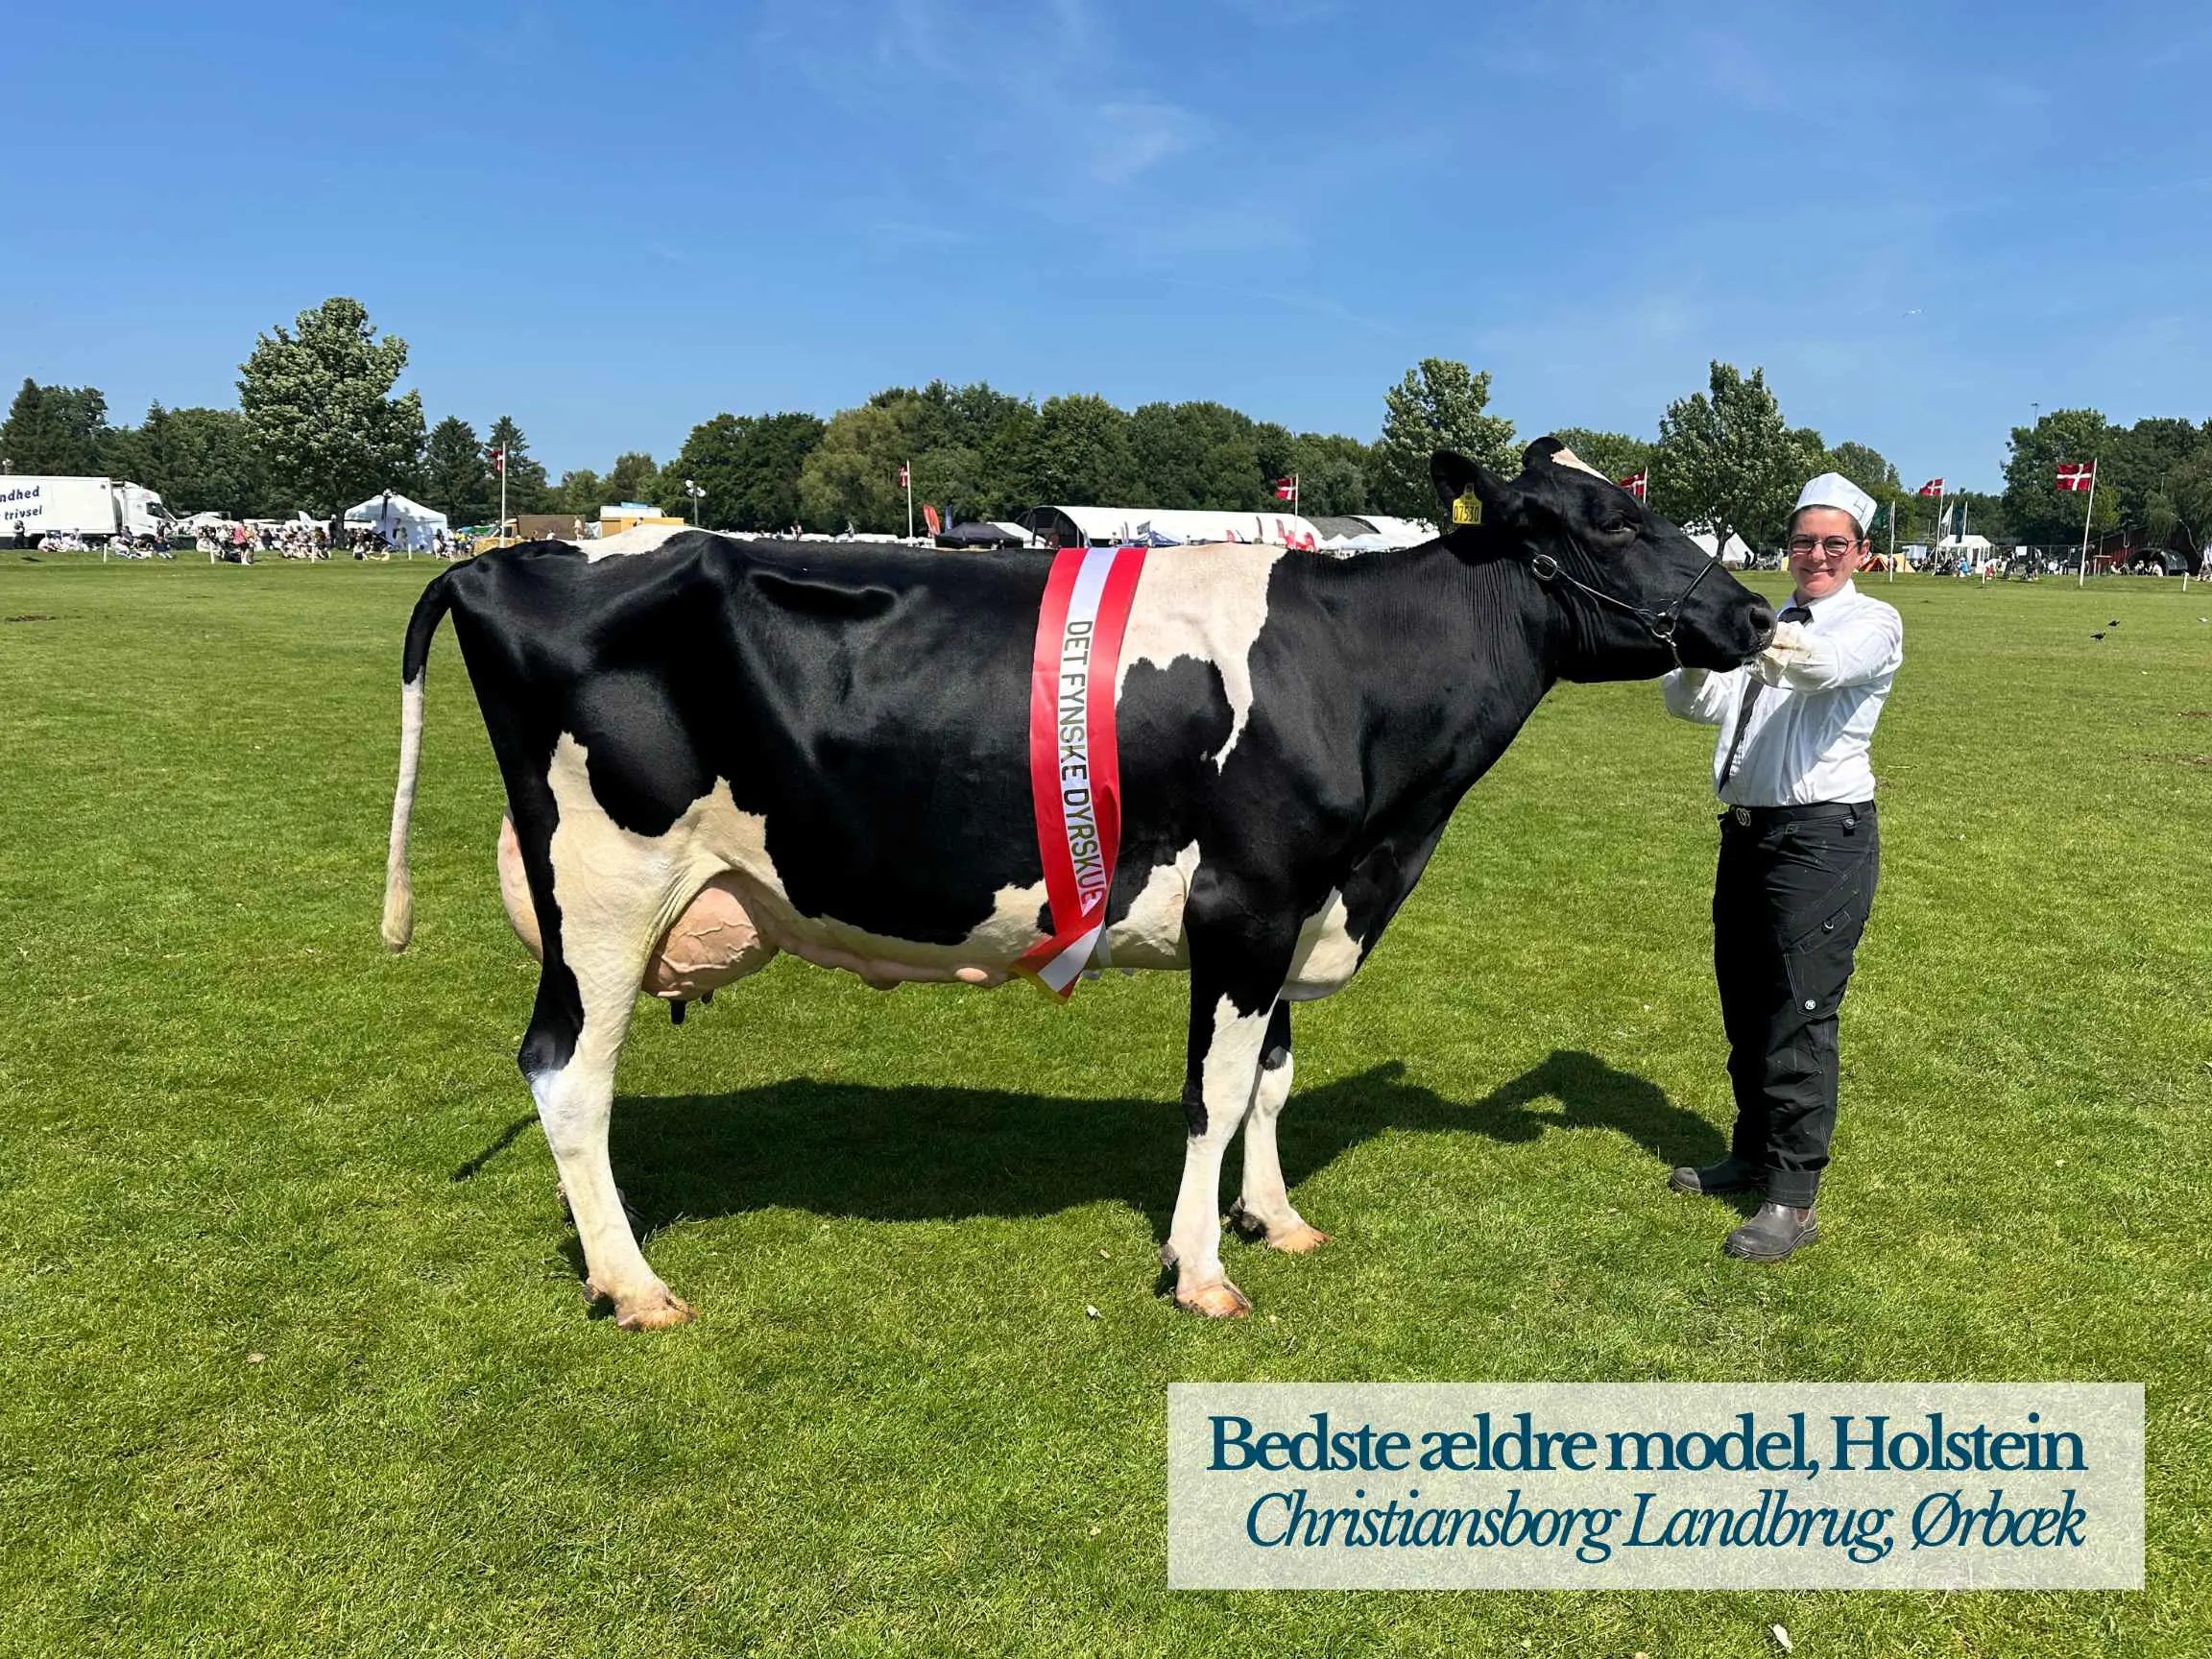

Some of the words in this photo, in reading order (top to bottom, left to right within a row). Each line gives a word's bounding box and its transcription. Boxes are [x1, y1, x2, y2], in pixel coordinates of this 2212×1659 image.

[5, 505, 43, 520] trivsel
[1063, 621, 1093, 666] DET
[1059, 673, 1087, 781] FYNSKE
